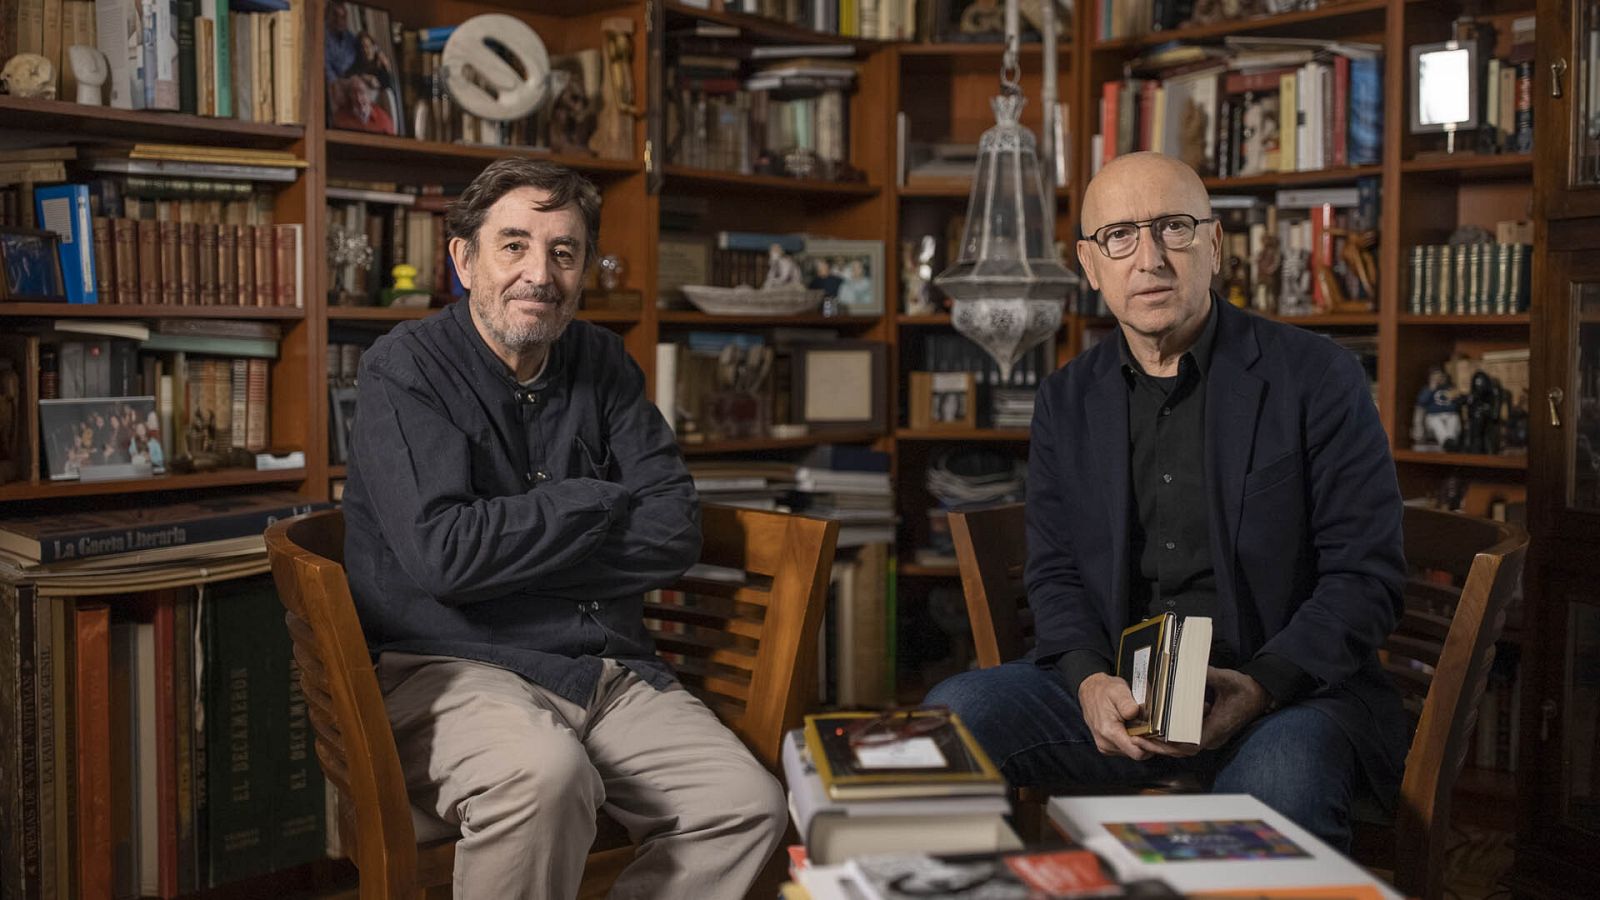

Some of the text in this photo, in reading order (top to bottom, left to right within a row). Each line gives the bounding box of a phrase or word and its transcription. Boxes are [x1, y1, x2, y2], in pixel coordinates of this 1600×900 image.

[54, 540, 74, 560] La
[127, 527, 186, 549] Literaria
[25, 676, 37, 860] POEMAS DE WALT WHITMAN
[289, 769, 306, 790] EL
[231, 780, 249, 801] EL
